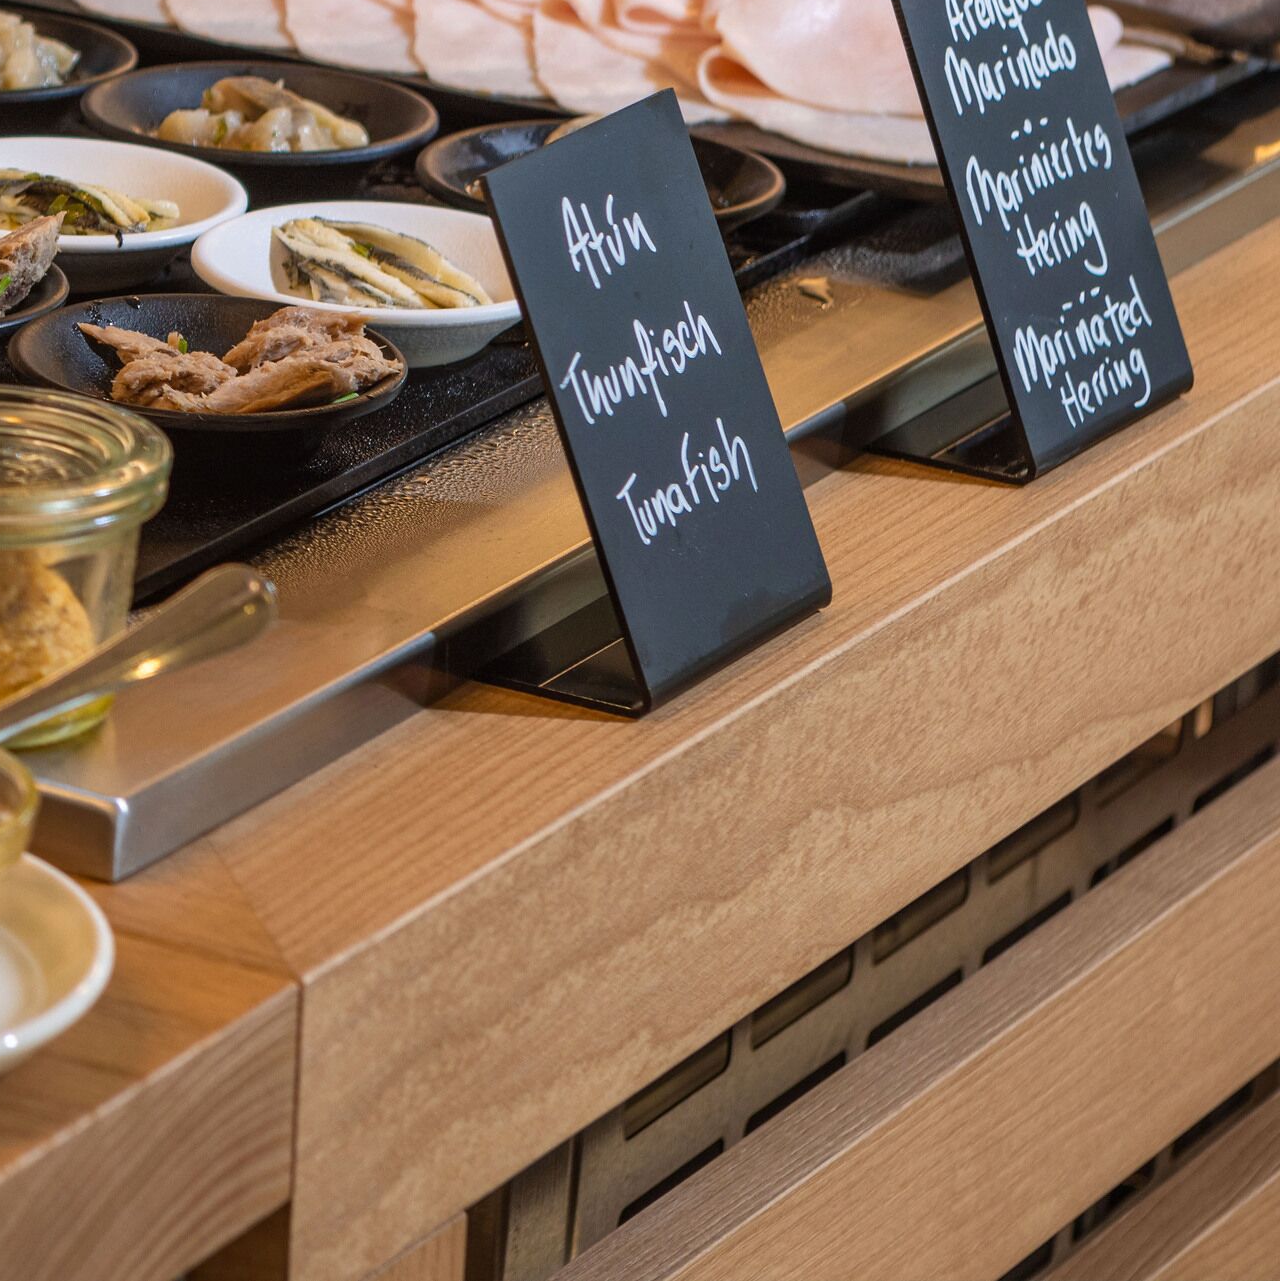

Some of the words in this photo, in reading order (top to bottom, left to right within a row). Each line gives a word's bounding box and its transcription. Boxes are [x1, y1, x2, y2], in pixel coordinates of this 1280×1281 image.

[944, 20, 1077, 116] Marinado
[1016, 201, 1108, 276] Hering
[559, 300, 722, 424] Thunfisch
[1014, 274, 1152, 393] Marinated
[1060, 347, 1151, 428] Herring
